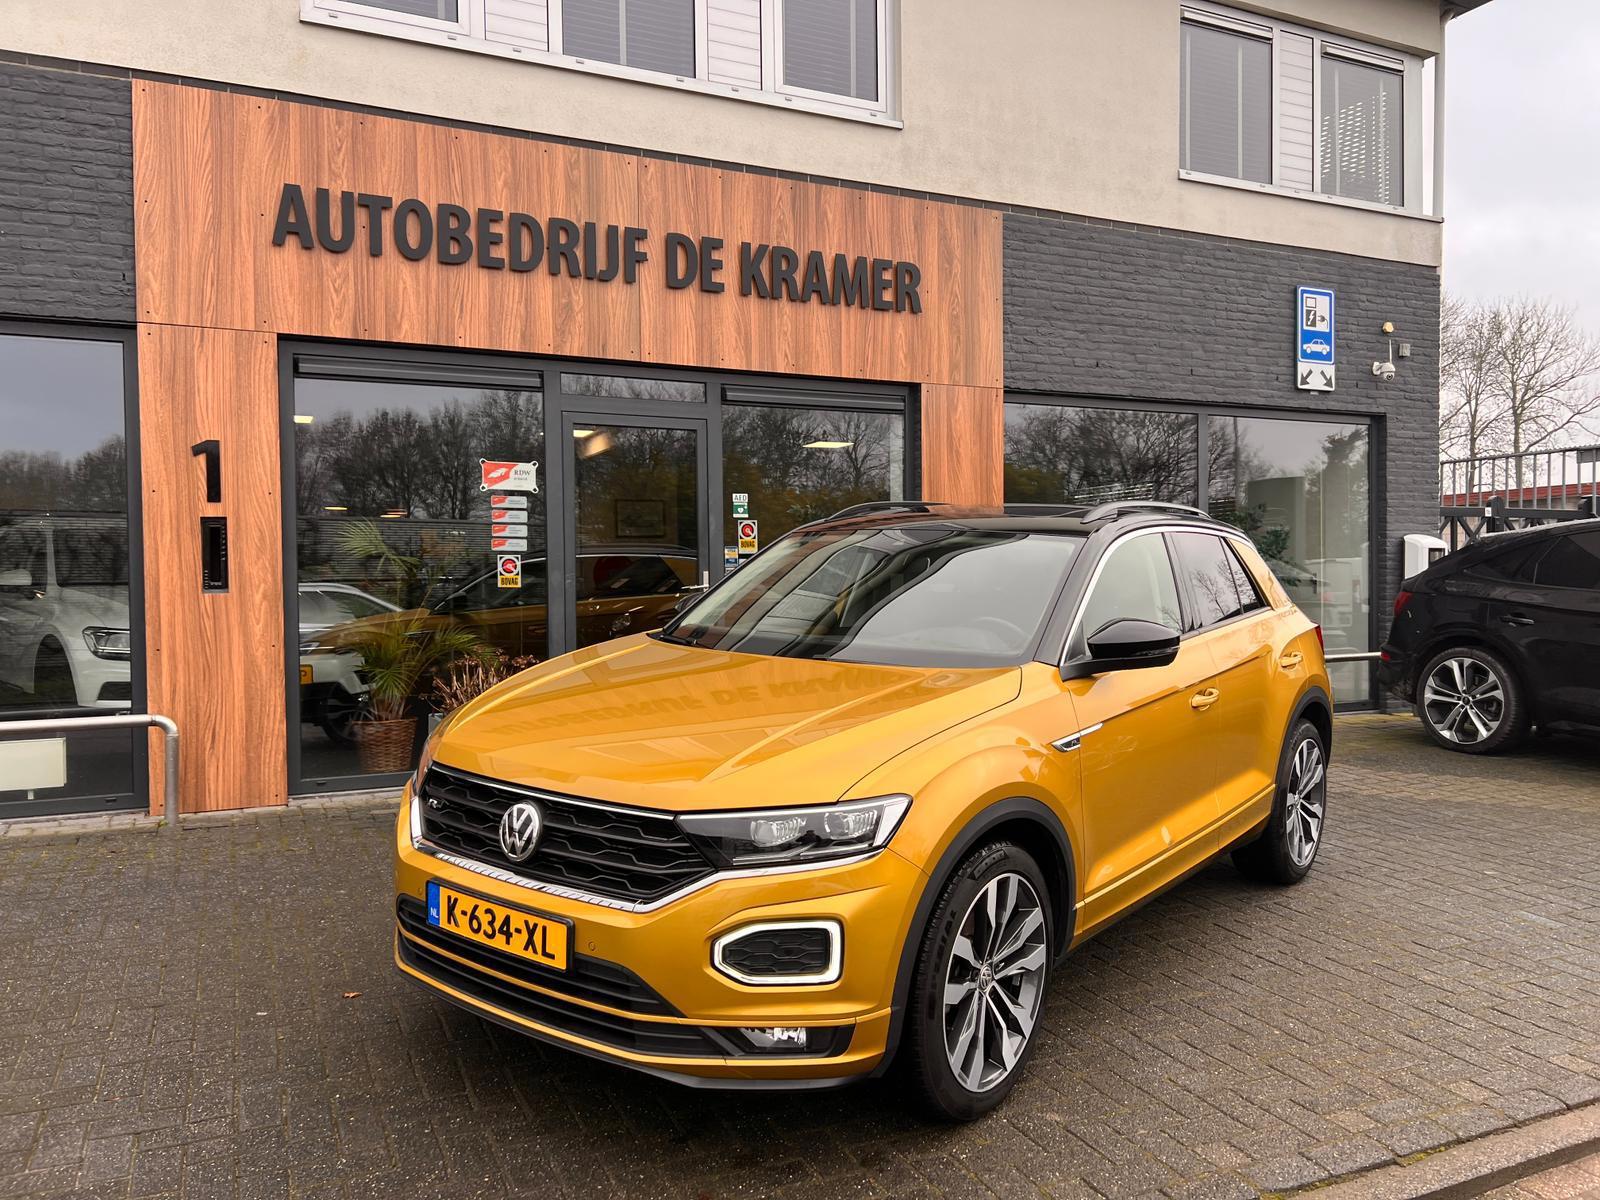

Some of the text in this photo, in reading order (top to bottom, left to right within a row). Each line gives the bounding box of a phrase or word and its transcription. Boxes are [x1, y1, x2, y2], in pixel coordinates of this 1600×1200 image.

[271, 183, 923, 314] AUTOBEDRIJF DE KRAMER
[191, 440, 222, 503] 1
[500, 577, 519, 586] BOVAG
[430, 906, 439, 919] NL
[446, 894, 556, 961] K-634-XL
